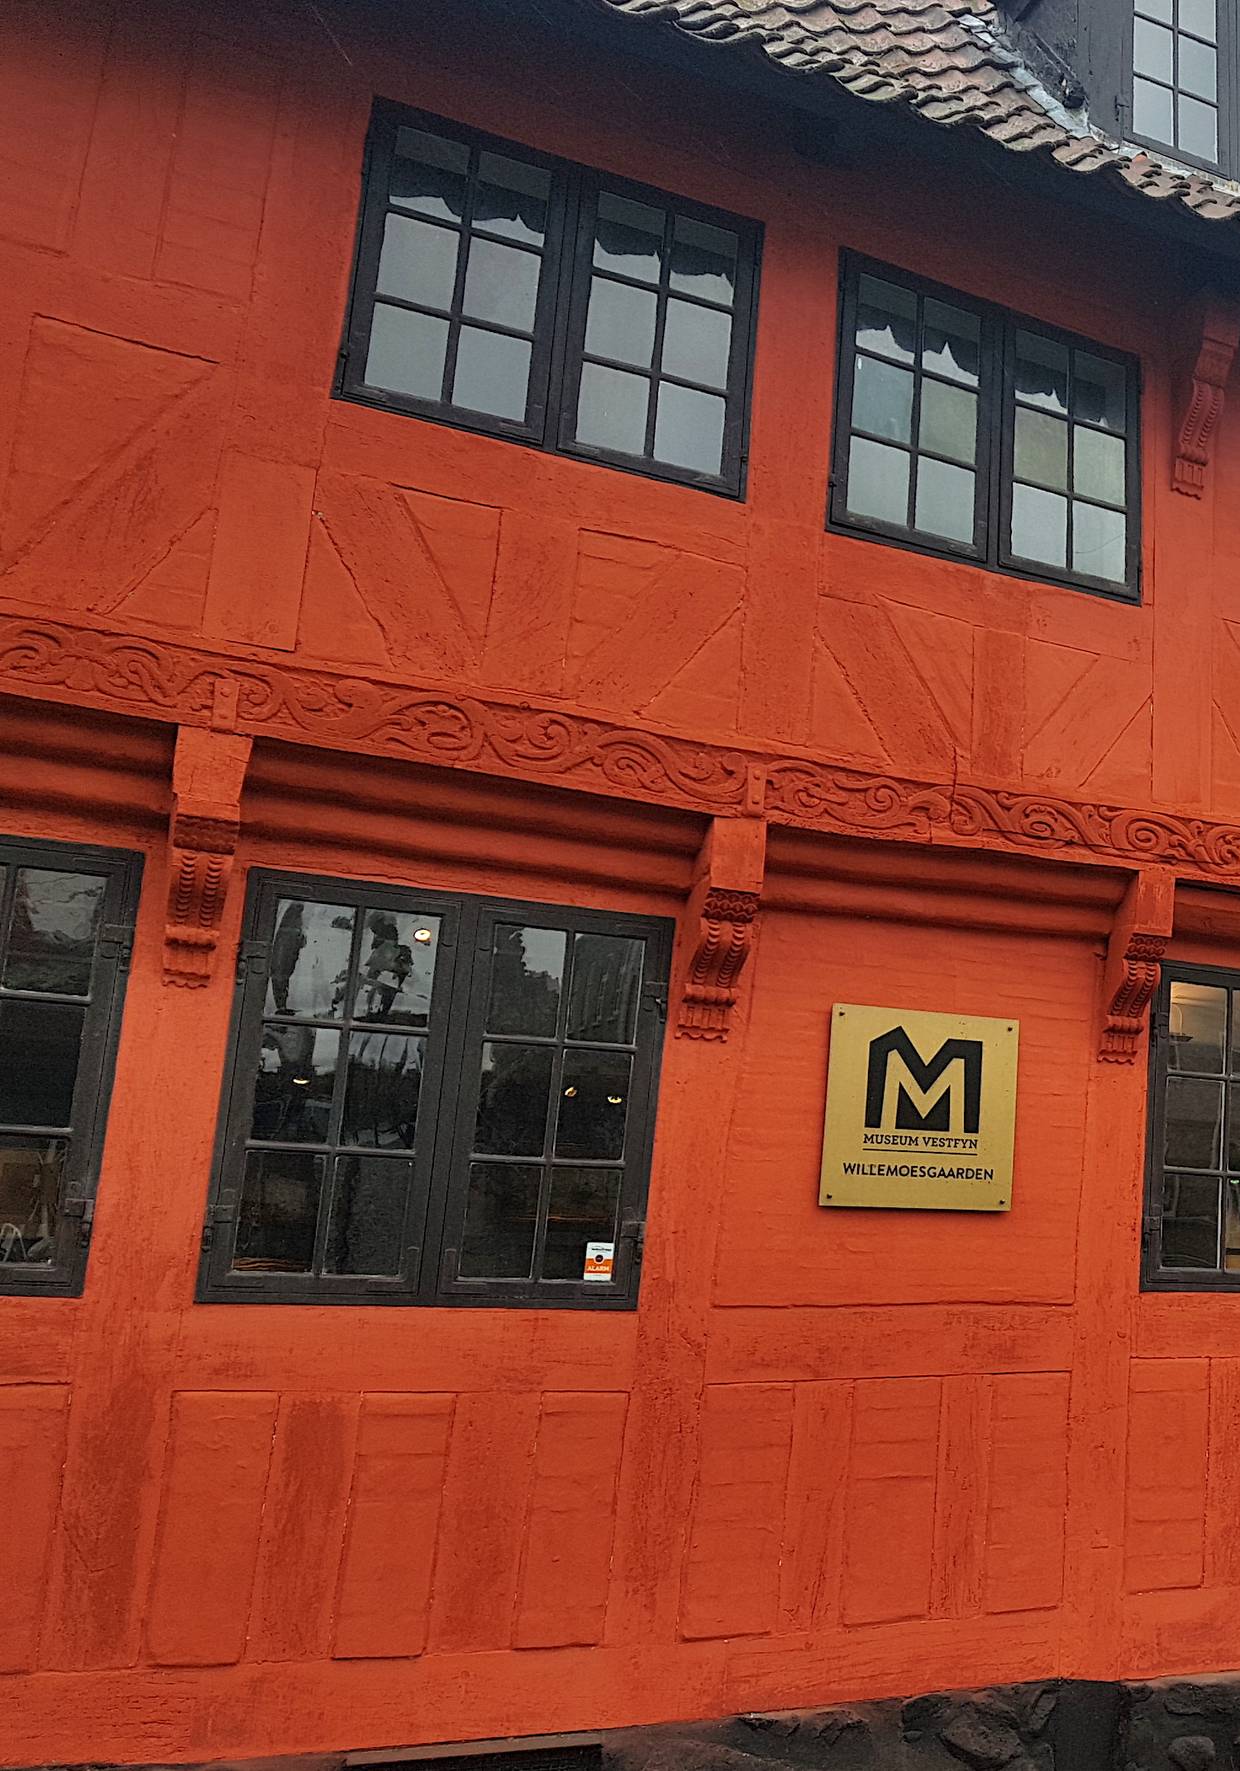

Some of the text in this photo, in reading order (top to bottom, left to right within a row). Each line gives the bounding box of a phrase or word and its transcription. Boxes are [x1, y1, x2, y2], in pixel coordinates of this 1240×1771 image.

[863, 1133, 978, 1149] MUSEUM VESTFYN
[843, 1162, 994, 1180] WILLEMOESGAARDEN
